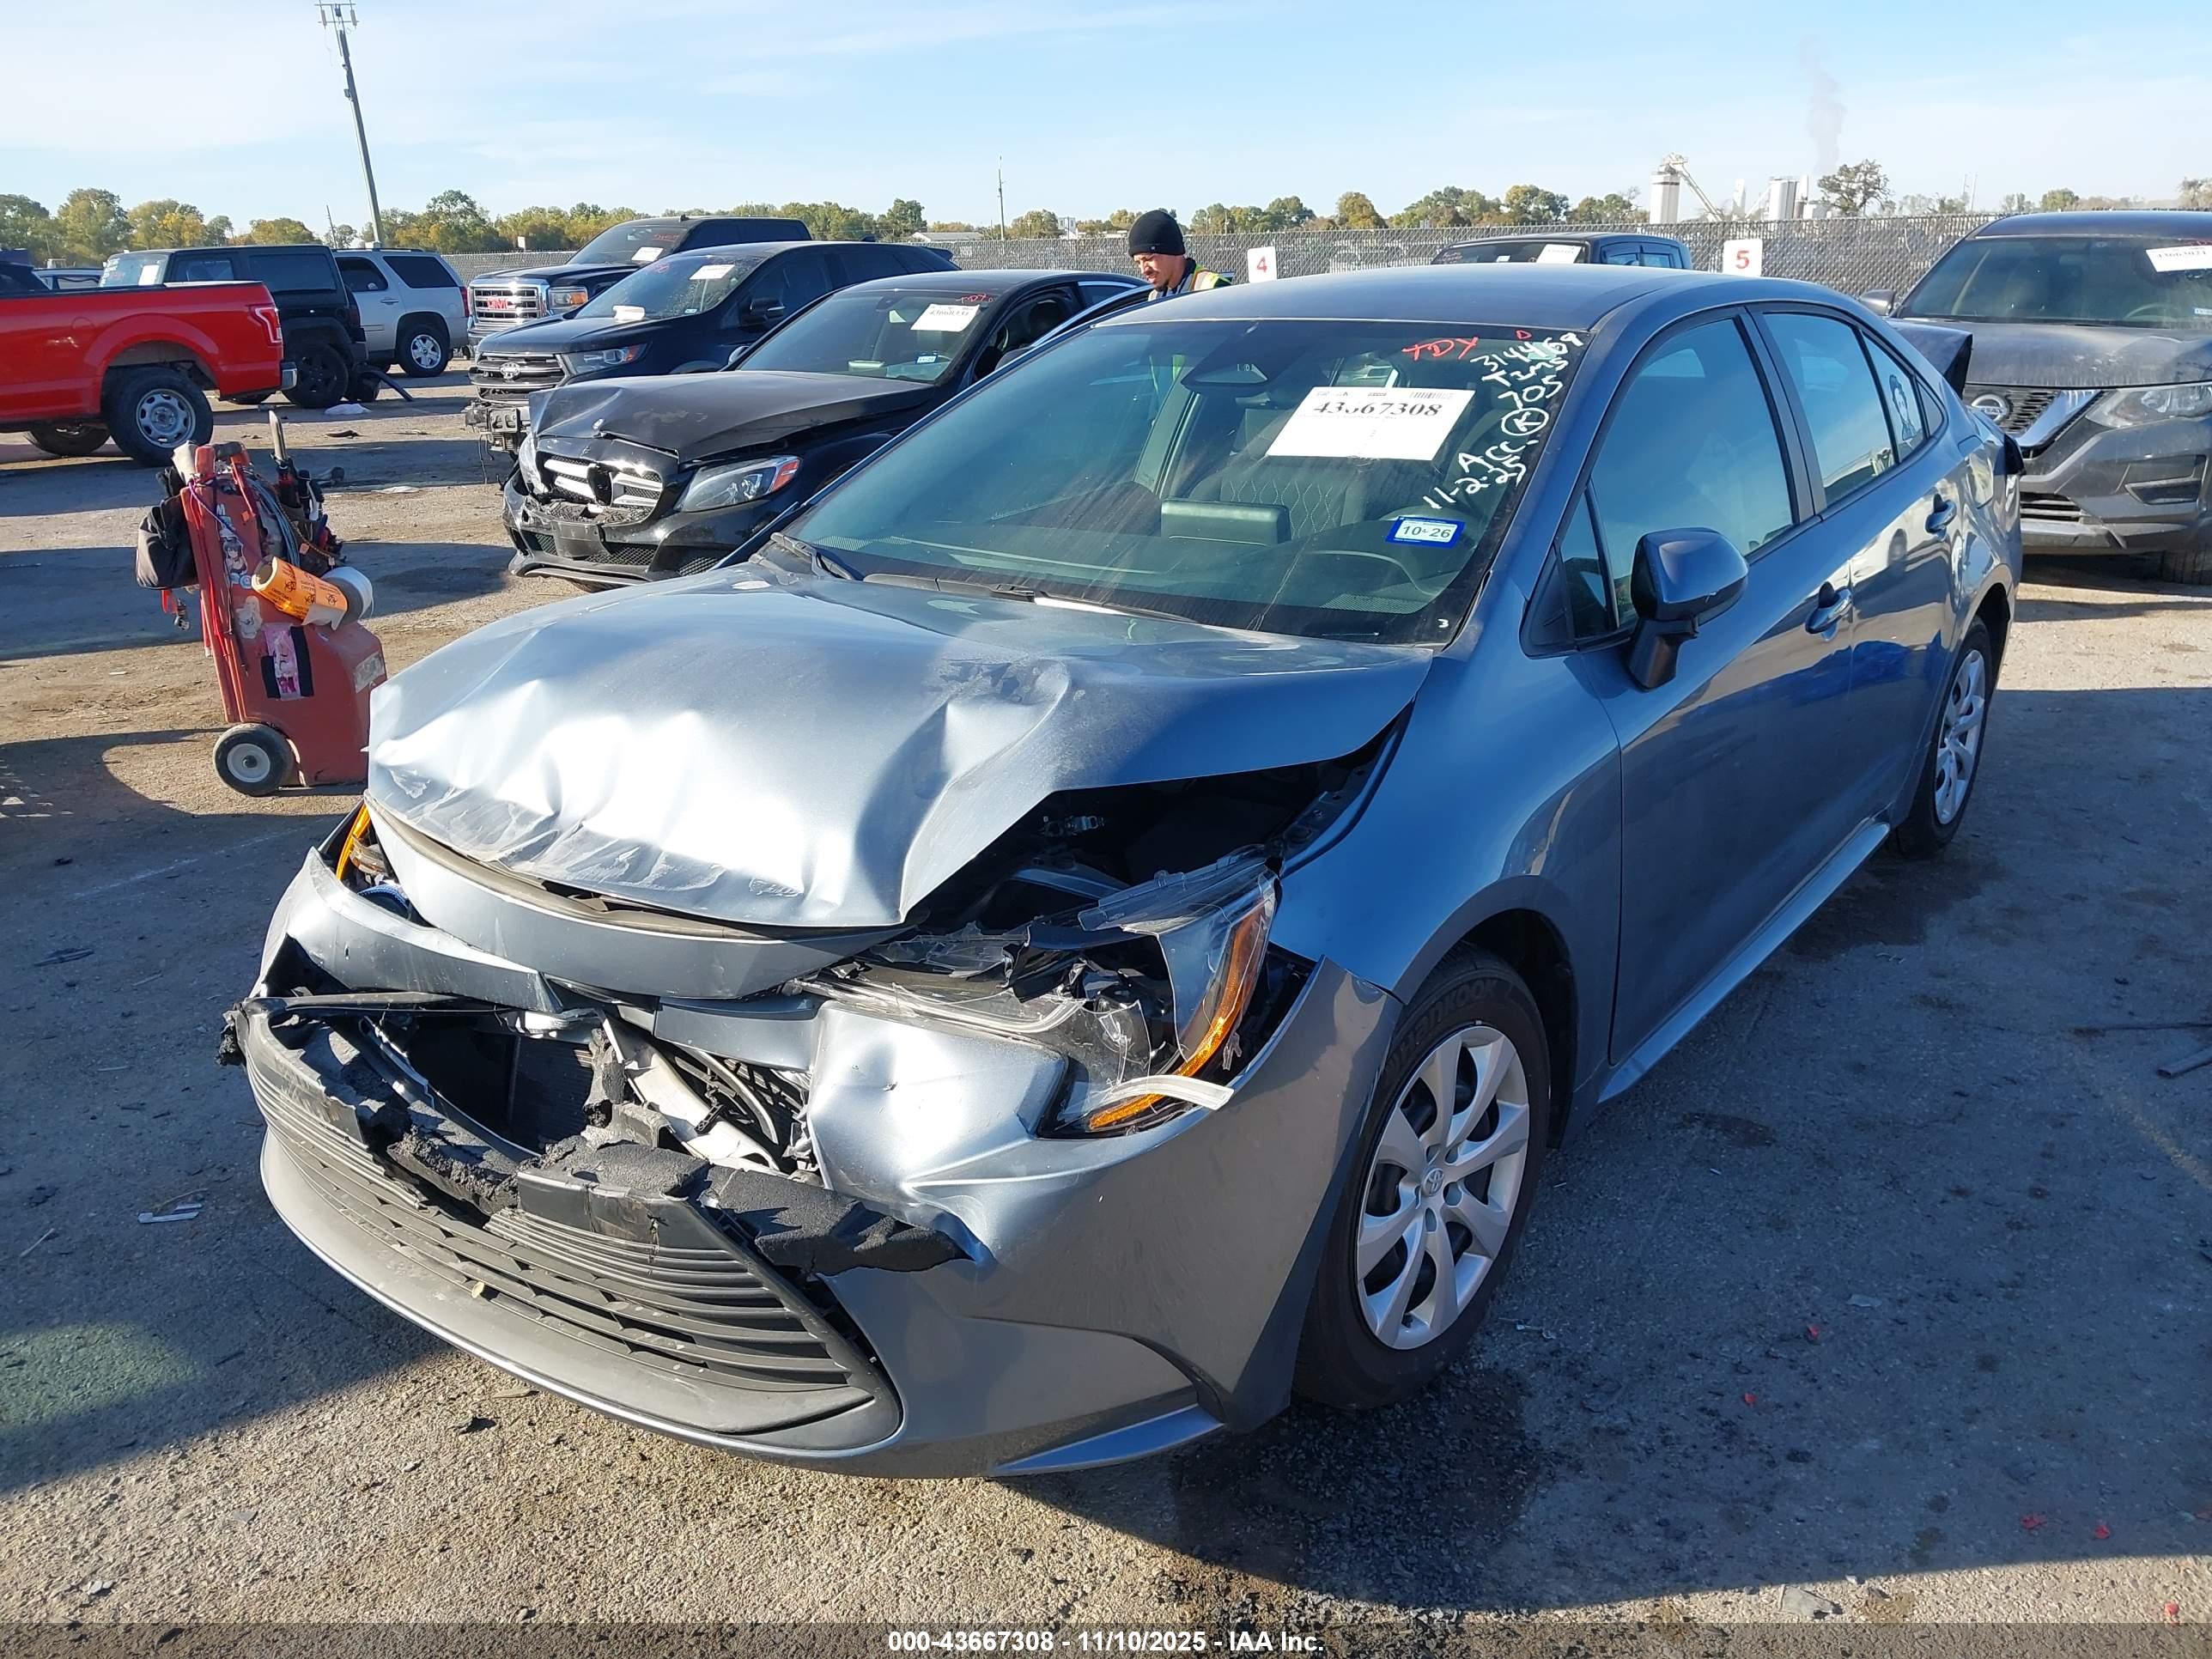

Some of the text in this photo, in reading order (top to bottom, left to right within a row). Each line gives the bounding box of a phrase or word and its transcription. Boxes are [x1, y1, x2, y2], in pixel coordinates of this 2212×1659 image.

[1257, 256, 1267, 273] 4
[1735, 250, 1749, 269] 5
[1401, 337, 1479, 362] TDY
